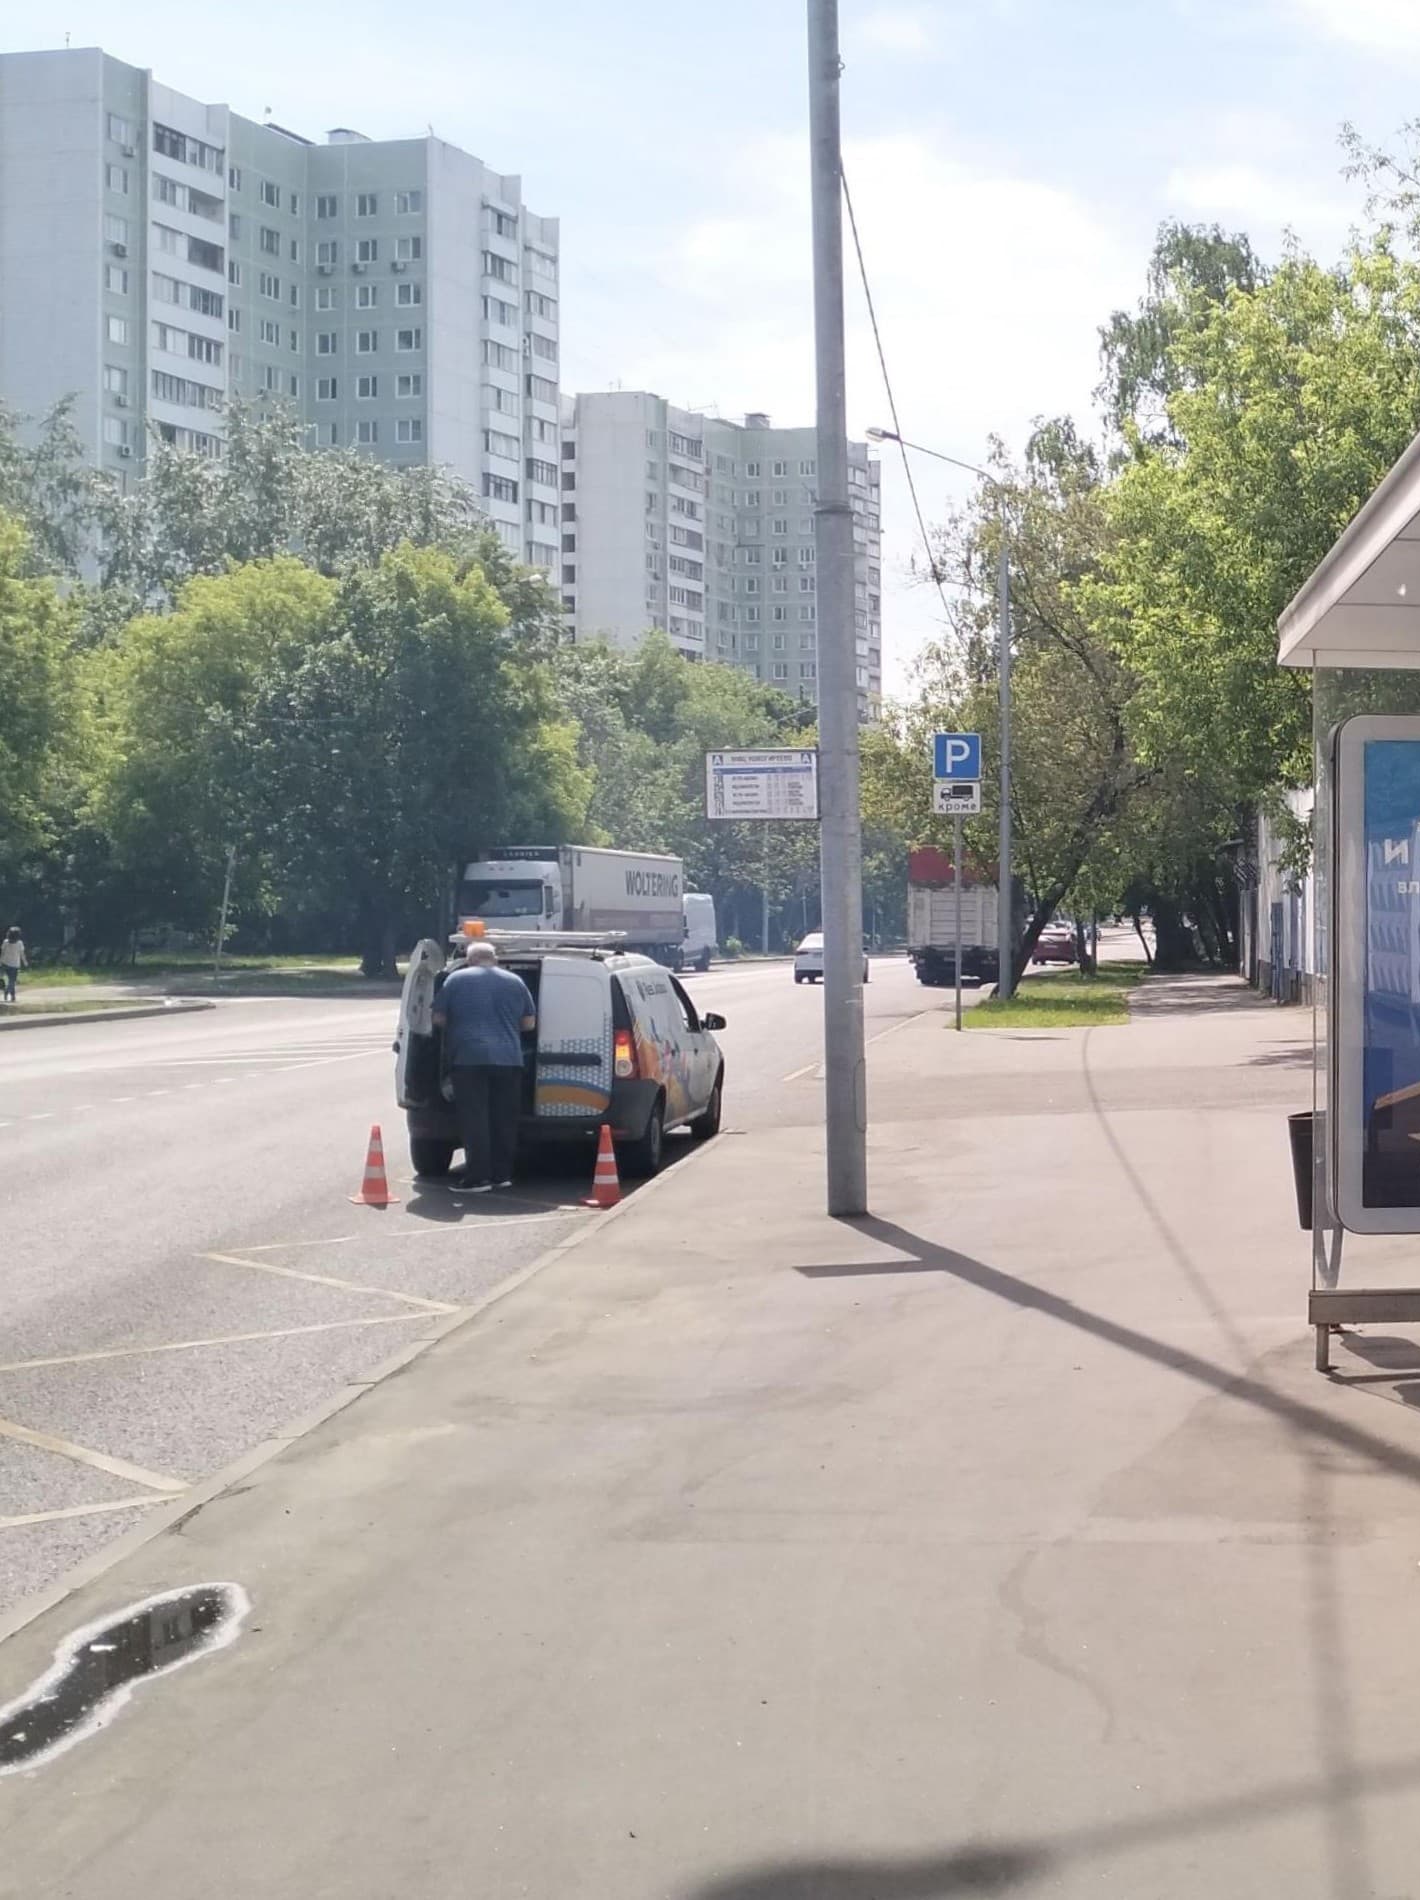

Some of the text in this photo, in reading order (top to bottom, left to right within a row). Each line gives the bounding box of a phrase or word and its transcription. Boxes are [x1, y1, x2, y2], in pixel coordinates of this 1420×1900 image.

[945, 739, 971, 774] P
[938, 802, 977, 812] кроме
[1384, 838, 1409, 865] И
